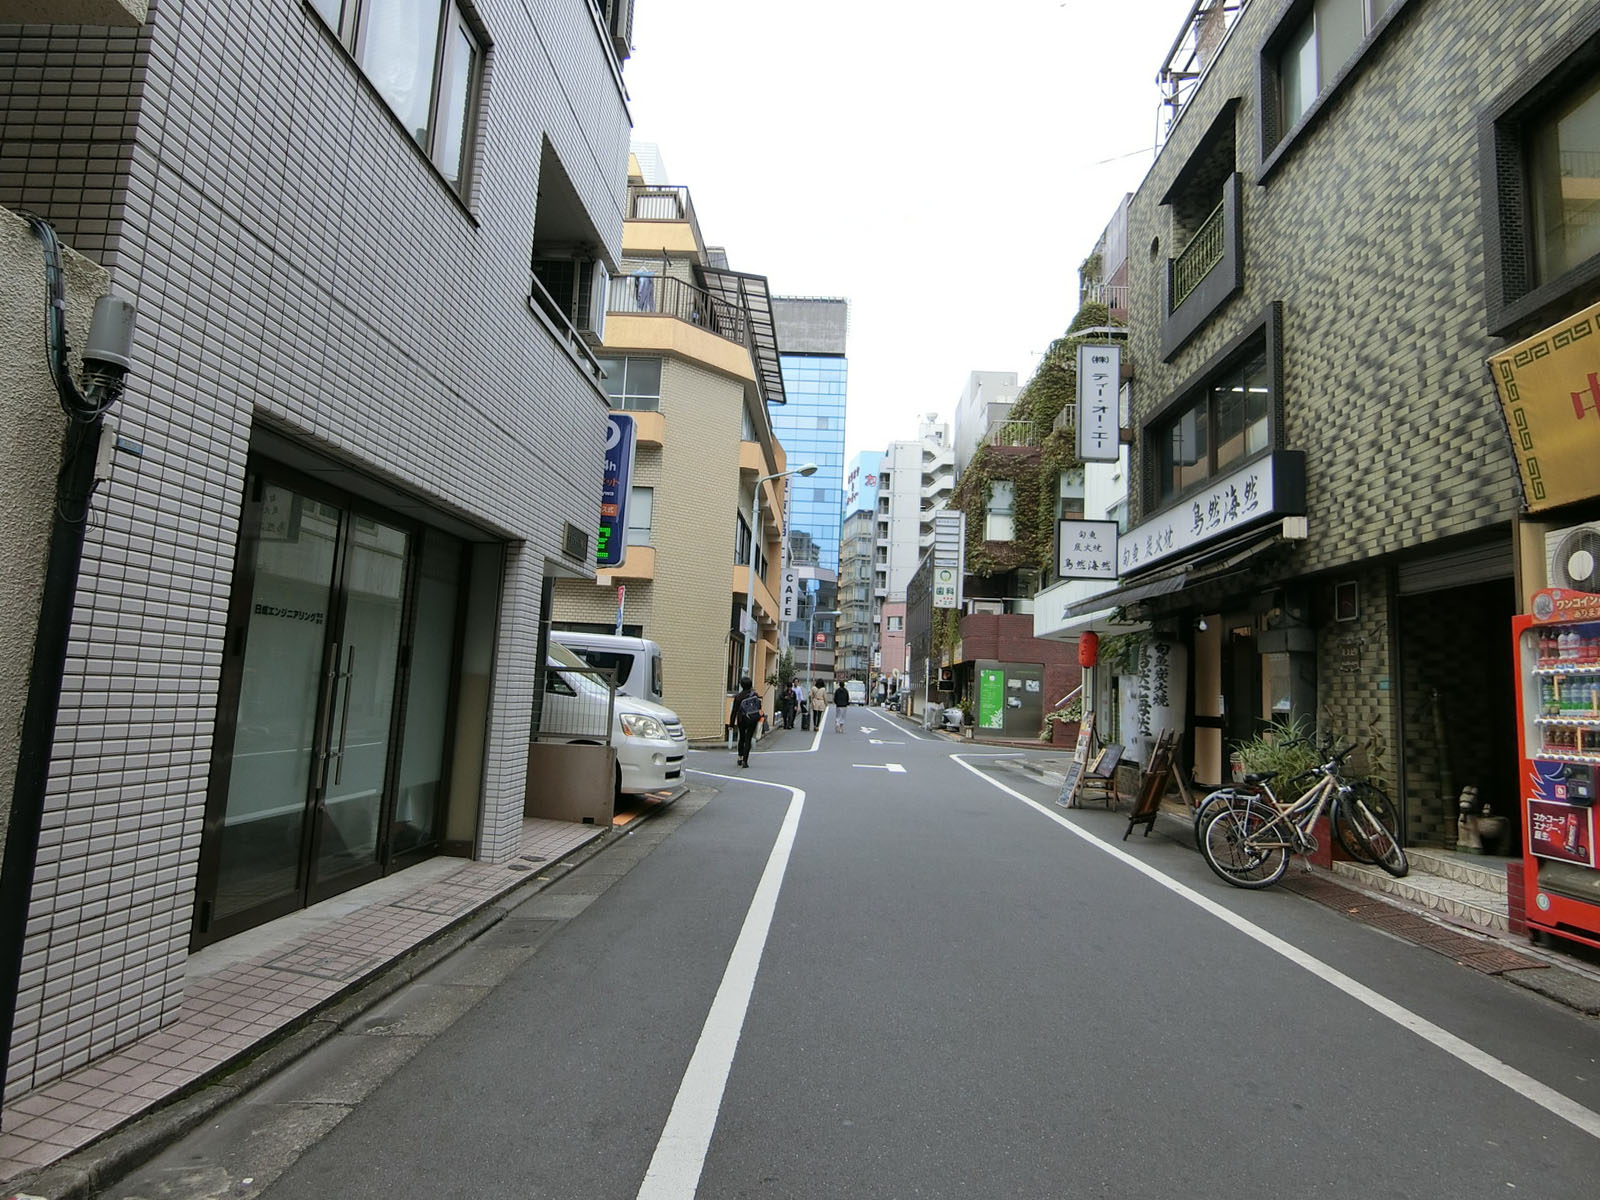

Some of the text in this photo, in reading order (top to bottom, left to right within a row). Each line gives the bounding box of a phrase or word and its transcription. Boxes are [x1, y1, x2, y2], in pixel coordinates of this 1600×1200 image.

[784, 574, 794, 616] CAFE
[1556, 595, 1600, 610] ワンコイン
